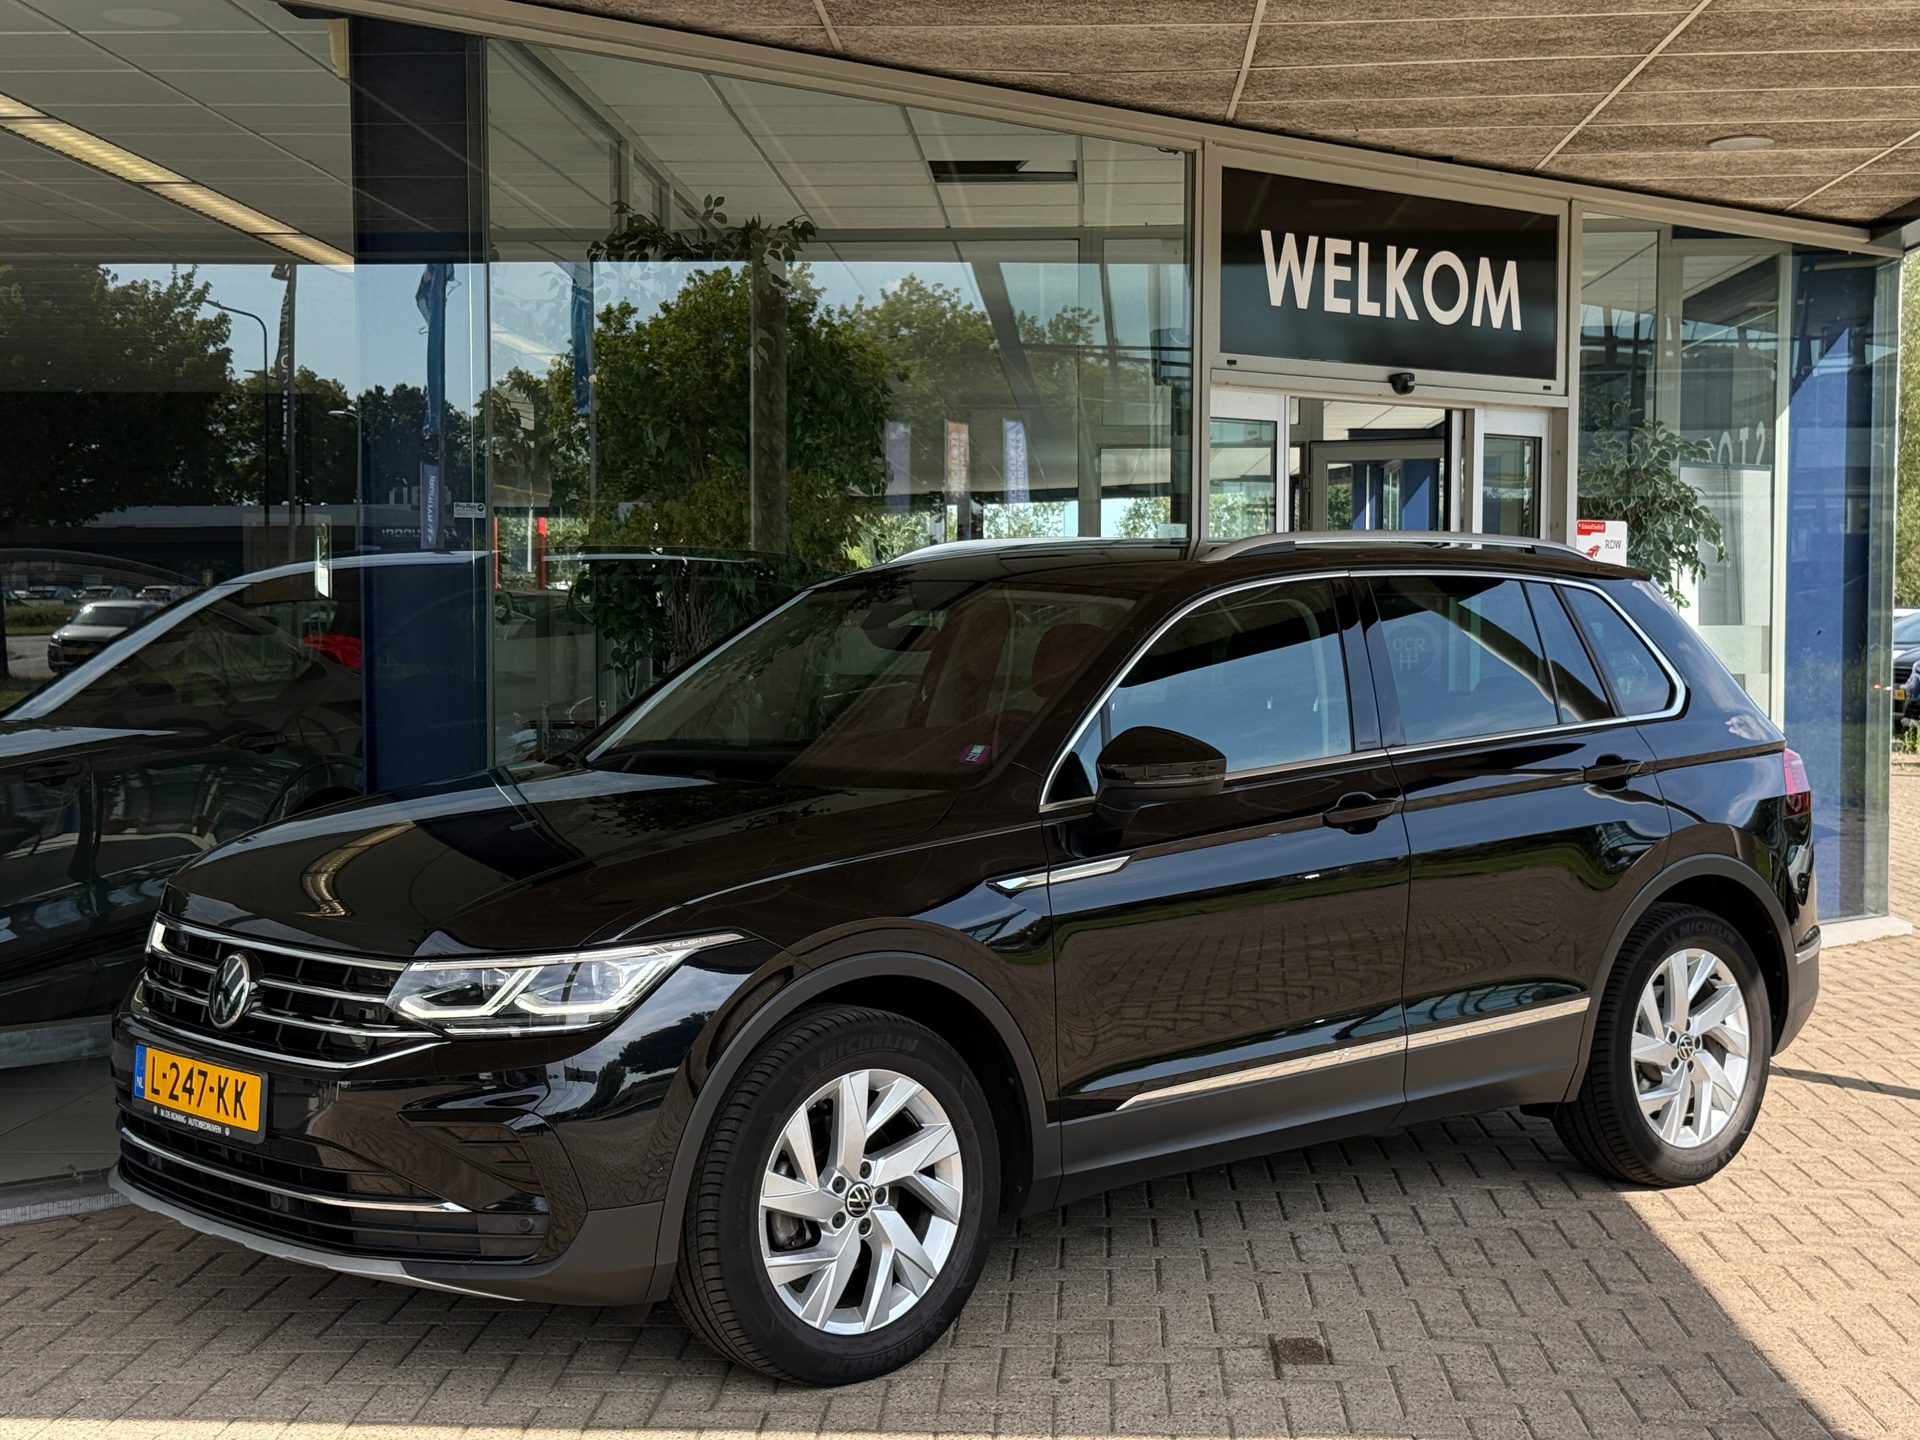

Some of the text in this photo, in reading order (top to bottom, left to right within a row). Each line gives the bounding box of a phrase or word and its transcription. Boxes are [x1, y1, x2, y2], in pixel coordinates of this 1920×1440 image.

[1261, 229, 1522, 331] WELKOM
[1604, 539, 1622, 550] RDW
[1393, 637, 1425, 652] OCR
[1679, 921, 1737, 945] MICHELIN
[818, 1033, 919, 1068] MICHELIN
[136, 1076, 144, 1089] NL
[151, 1056, 247, 1121] L-247-KK
